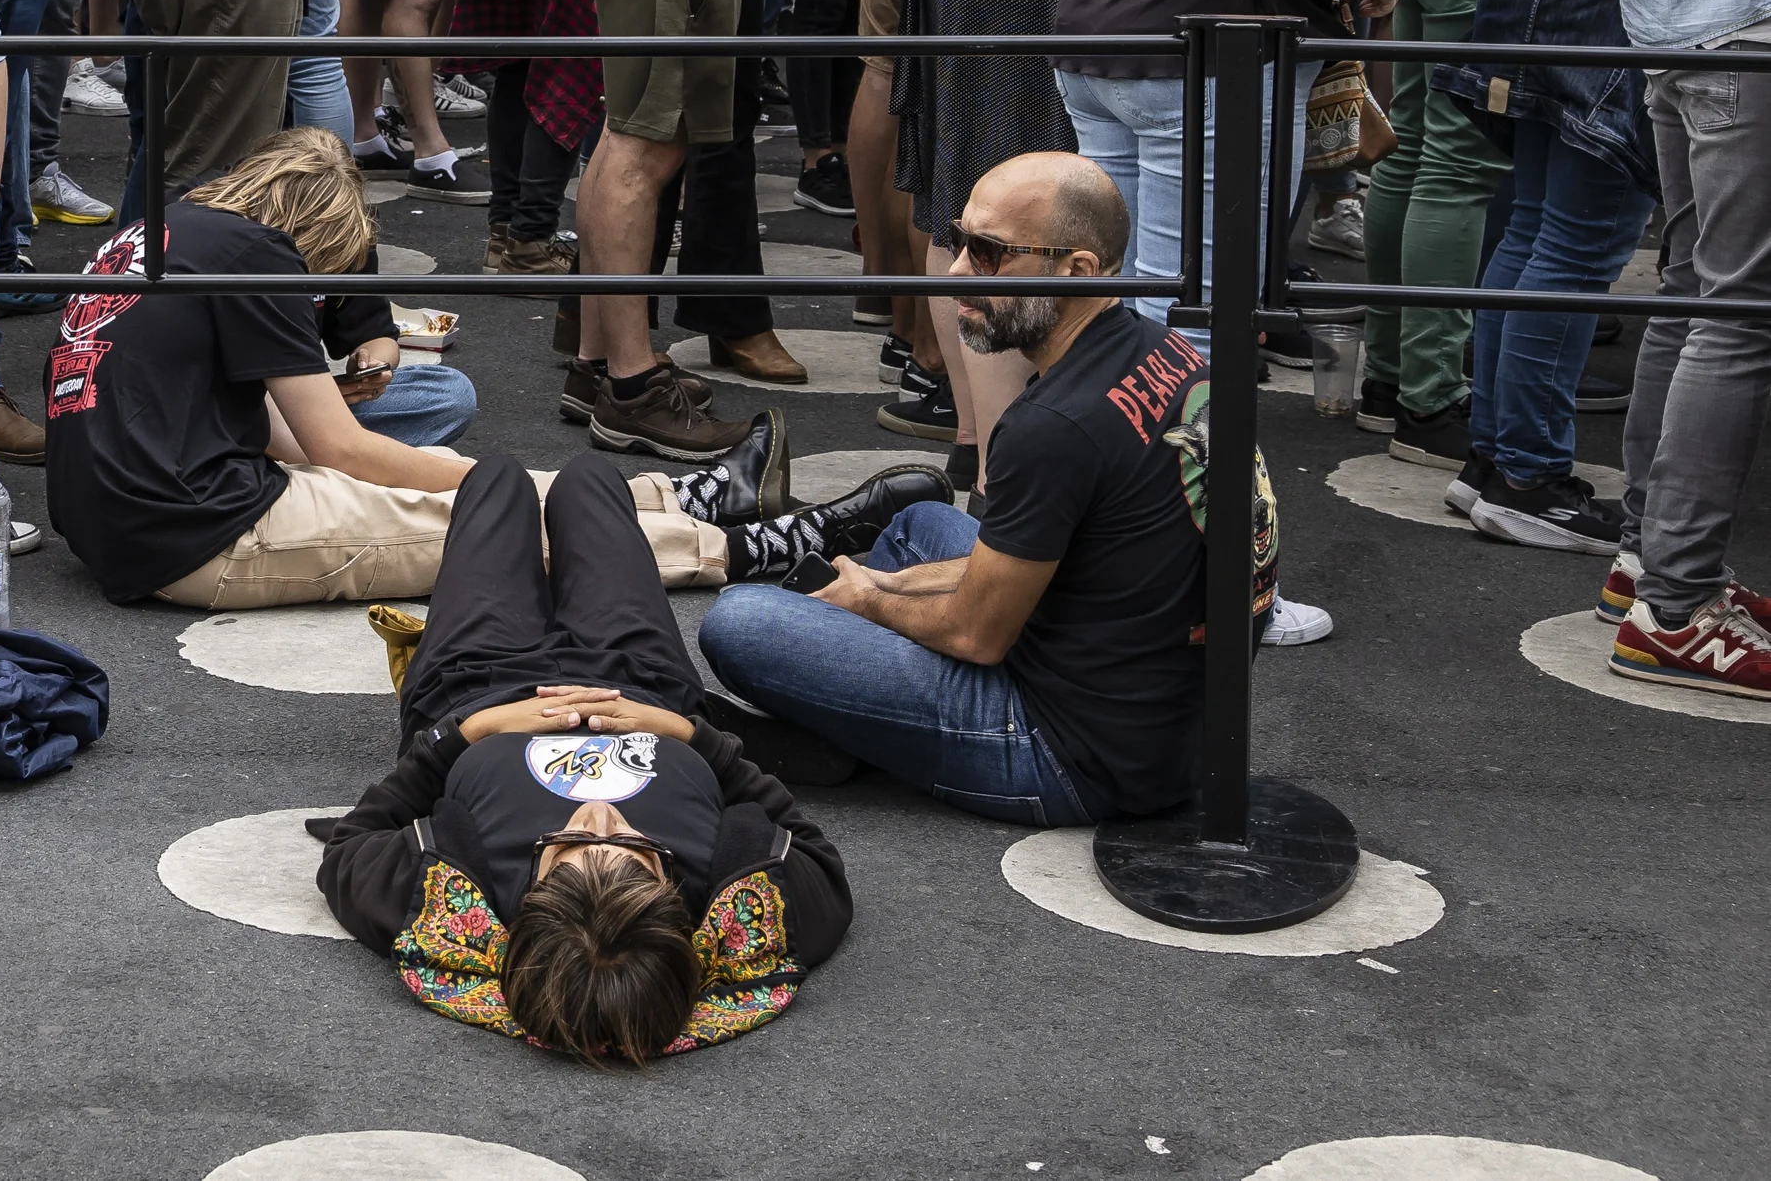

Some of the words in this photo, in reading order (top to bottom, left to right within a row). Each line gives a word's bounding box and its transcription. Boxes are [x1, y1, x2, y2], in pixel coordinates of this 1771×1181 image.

[1106, 348, 1188, 445] PEARL
[1164, 329, 1210, 372] JA
[1253, 593, 1271, 612] UNE
[1691, 637, 1748, 673] N
